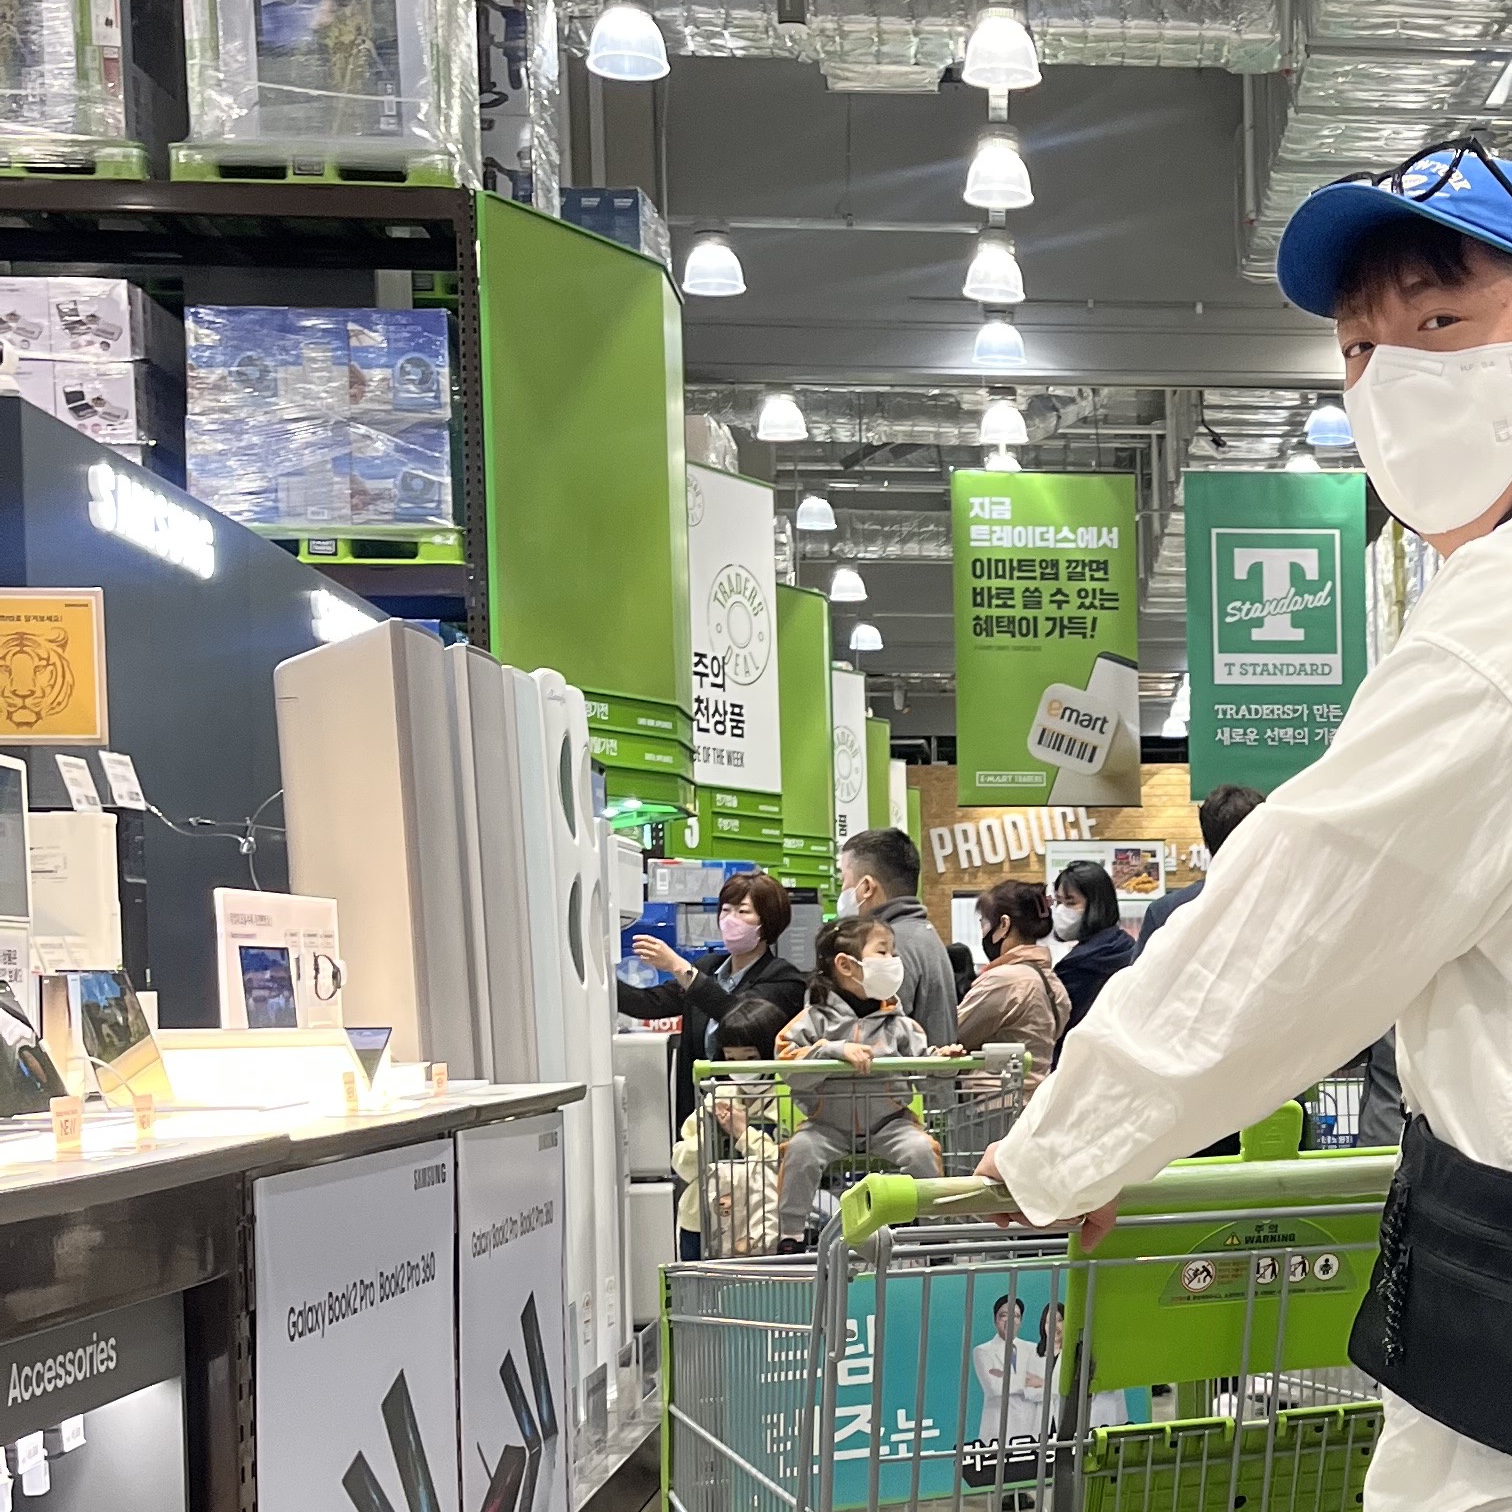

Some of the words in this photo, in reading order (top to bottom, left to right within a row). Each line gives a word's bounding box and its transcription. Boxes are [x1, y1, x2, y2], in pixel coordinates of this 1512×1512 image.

[969, 496, 1012, 520] 지금
[969, 524, 1119, 549] 트레이더스에서
[971, 557, 1060, 581] 이마트앱
[1065, 558, 1109, 582] 깔면
[713, 572, 764, 617] TRADERS
[972, 586, 1016, 610] 바로
[1021, 587, 1043, 610] 쓸
[1049, 588, 1070, 610] 수
[1076, 588, 1120, 611] 있는
[1225, 580, 1332, 623] Standard
[972, 614, 1039, 639] 혜택이
[1044, 616, 1098, 639] 가득!
[692, 651, 726, 693] 주의
[1224, 663, 1236, 677] T
[1239, 663, 1332, 676] STANDARD
[1047, 699, 1110, 735] emart
[1214, 703, 1309, 722] TRADERS가
[1313, 703, 1344, 722] 만든
[1215, 726, 1260, 746] 새로운
[1264, 726, 1309, 746] 선택의
[712, 747, 725, 766] THE
[726, 749, 745, 769] WEEK
[413, 1162, 447, 1191] SAMSUNG
[1244, 1233, 1296, 1245] WARNING
[287, 1299, 327, 1343] Galaxy
[327, 1281, 359, 1326] Book2
[359, 1278, 375, 1312] Pro
[379, 1262, 406, 1303] Book2
[406, 1260, 420, 1292] Pro
[421, 1250, 436, 1285] 360
[8, 1333, 118, 1405] Accessories
